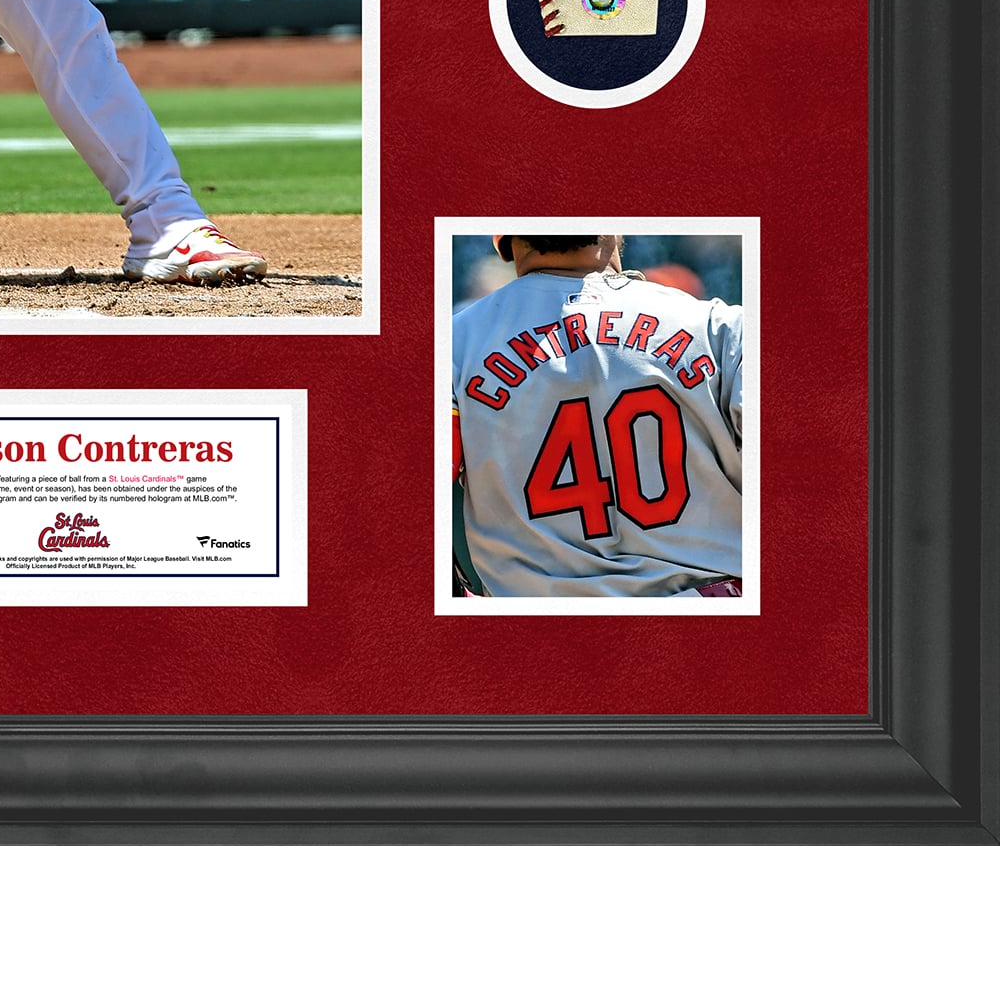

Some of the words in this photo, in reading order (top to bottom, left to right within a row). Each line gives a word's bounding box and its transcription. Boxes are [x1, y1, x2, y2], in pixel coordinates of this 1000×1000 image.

[465, 311, 716, 411] CONTRERAS
[58, 434, 233, 462] Contreras
[523, 383, 691, 541] 40
[39, 475, 57, 483] piece
[45, 485, 76, 493] season),
[183, 485, 214, 493] auspices
[89, 495, 97, 503] by
[148, 495, 182, 503] hologram
[38, 527, 110, 552] Cardinals
[211, 539, 251, 548] Fanatics
[144, 555, 164, 563] League
[6, 562, 30, 570] Officially
[103, 562, 124, 570] Players,
